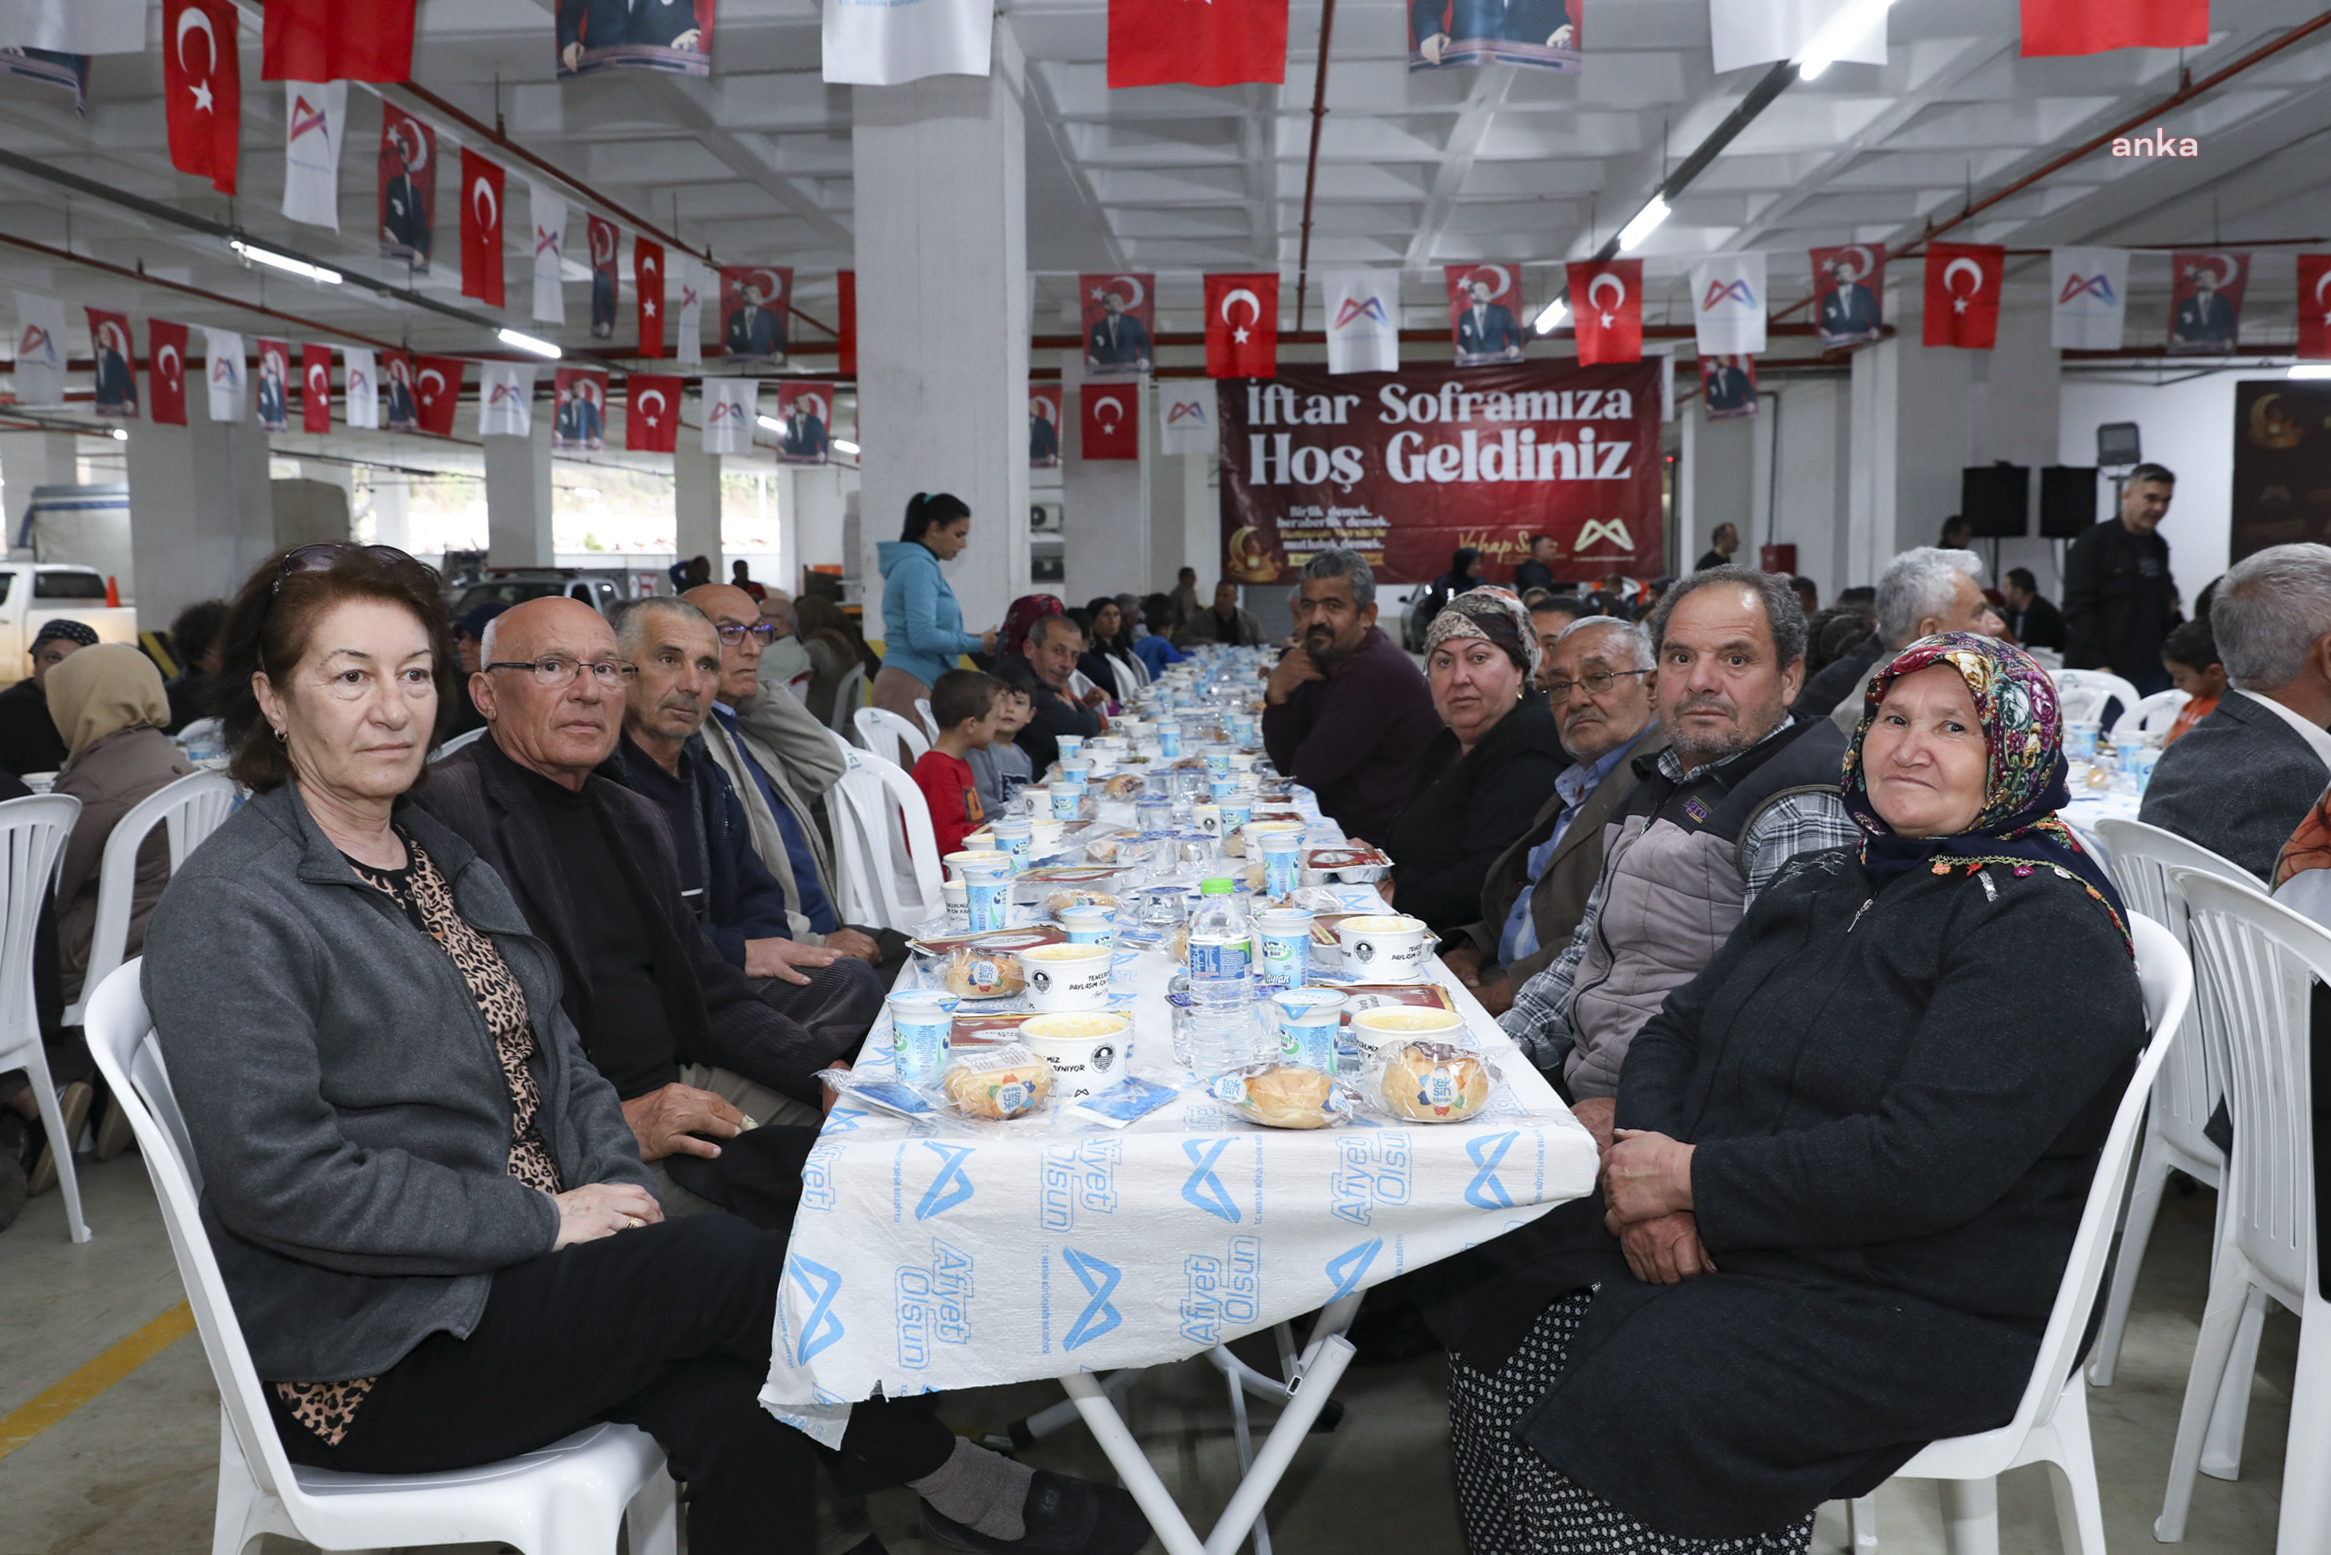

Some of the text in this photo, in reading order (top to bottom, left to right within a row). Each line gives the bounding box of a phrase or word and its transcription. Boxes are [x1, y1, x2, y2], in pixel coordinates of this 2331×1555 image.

[1246, 377, 1633, 426] İftar Soframıza
[1249, 426, 1632, 494] Hoş Geldiniz
[1432, 1076, 1451, 1087] tek
[1433, 1087, 1451, 1096] sin
[1338, 1140, 1374, 1221] Afiyet
[901, 1271, 930, 1363] Olsun
[934, 1247, 968, 1343] Afiyet
[1187, 1260, 1222, 1342] Afiyet
[1225, 1240, 1254, 1319] Olsun
